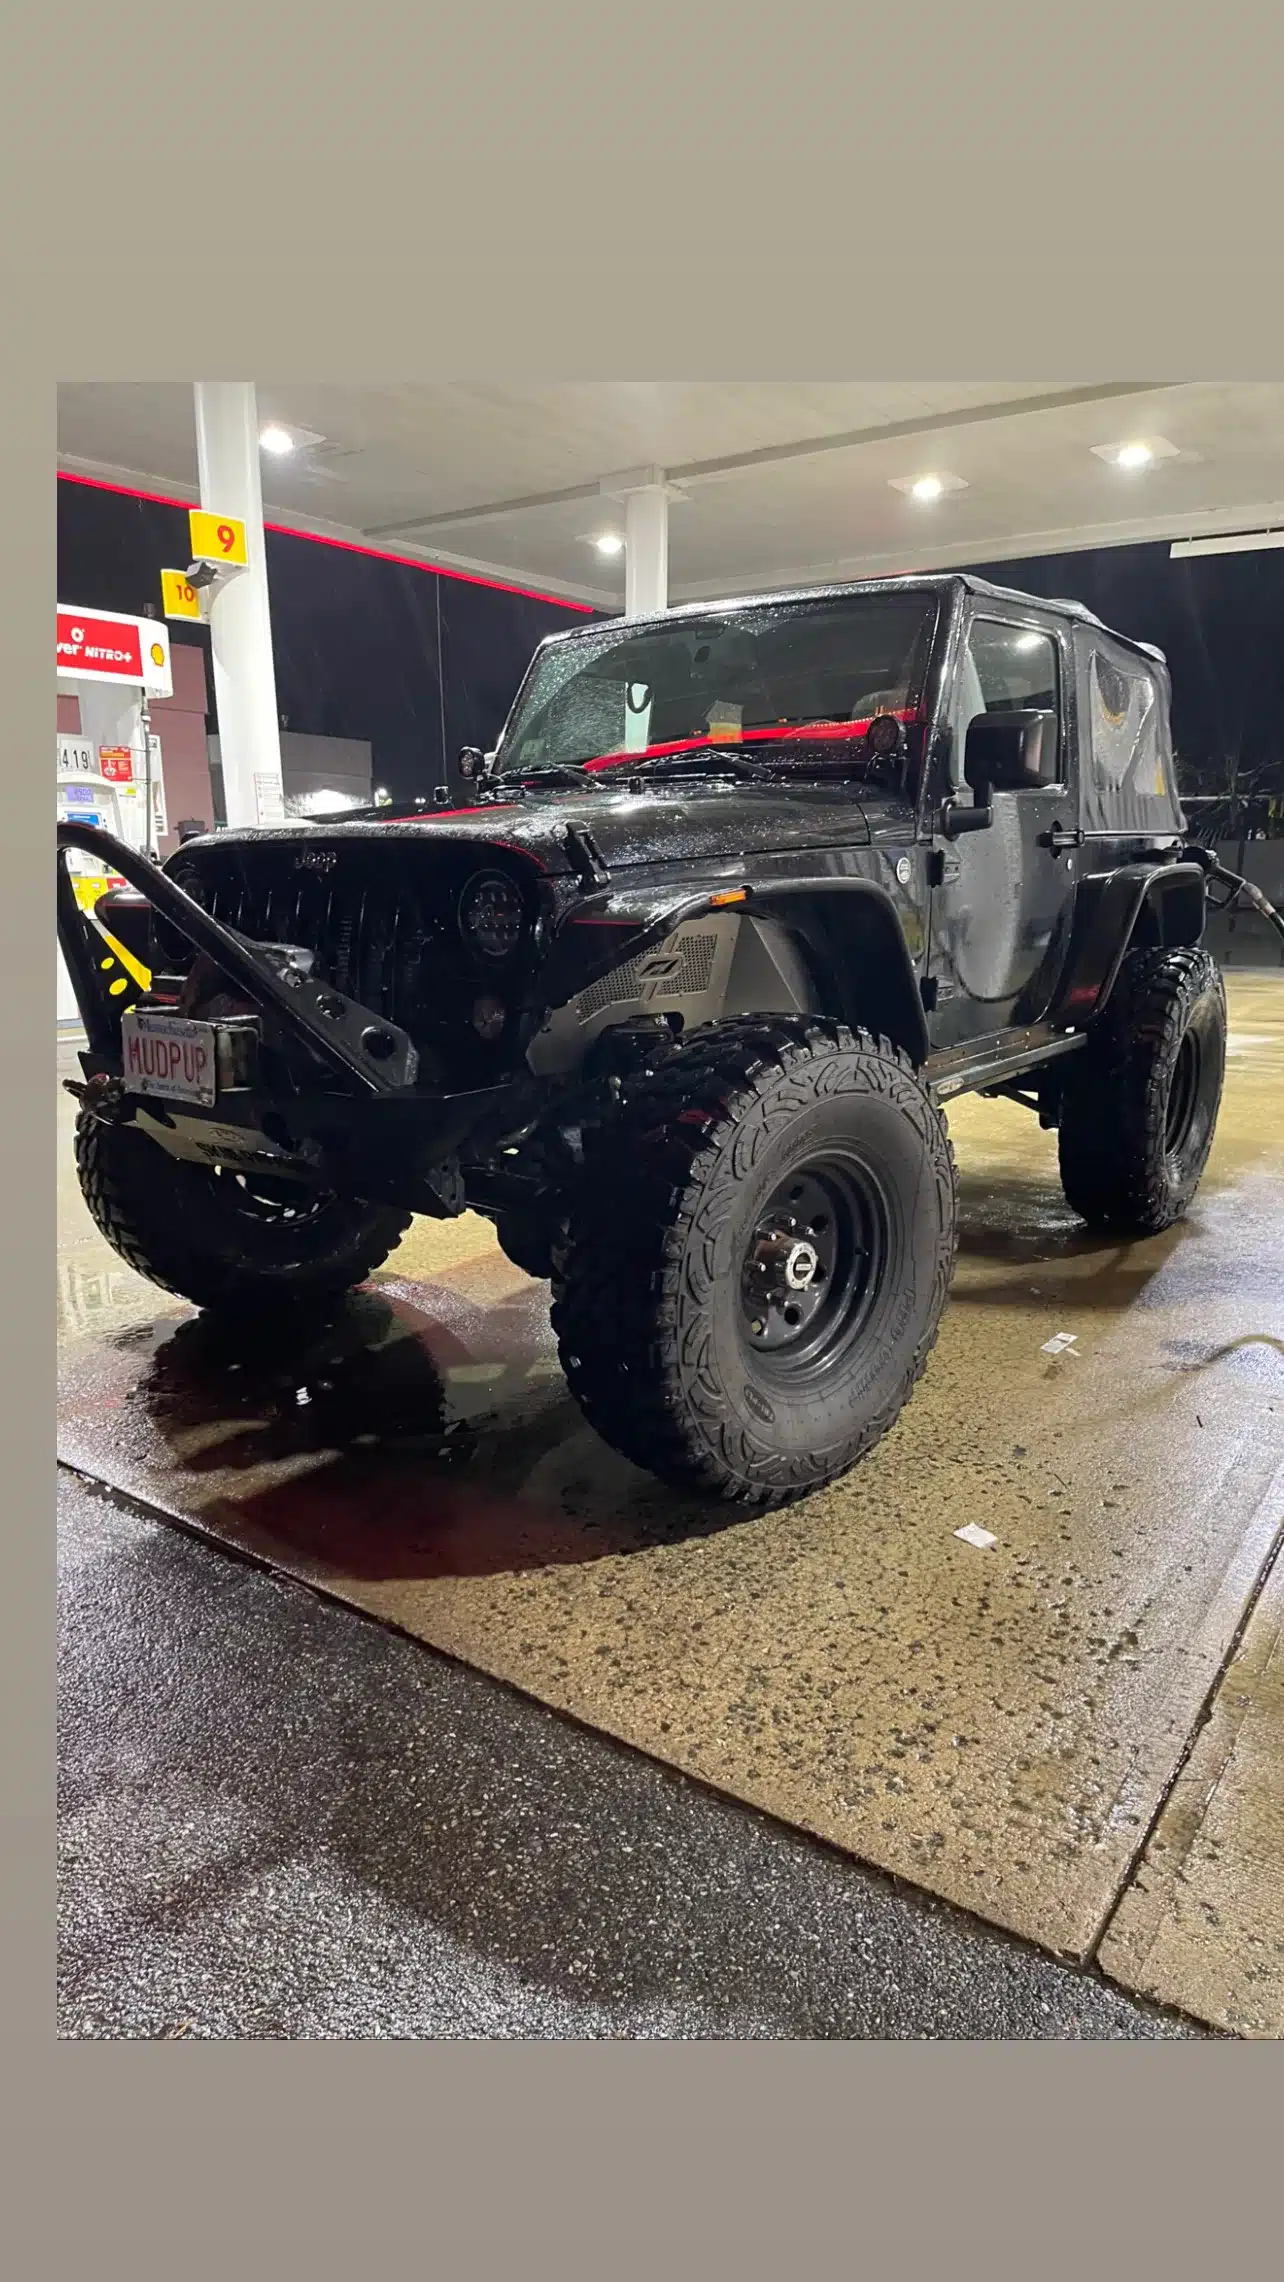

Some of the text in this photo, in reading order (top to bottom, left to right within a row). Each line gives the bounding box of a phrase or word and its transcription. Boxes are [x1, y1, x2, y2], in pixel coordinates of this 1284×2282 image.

[217, 525, 236, 553] 9
[176, 584, 196, 602] 10
[127, 1035, 208, 1085] MUDPUP
